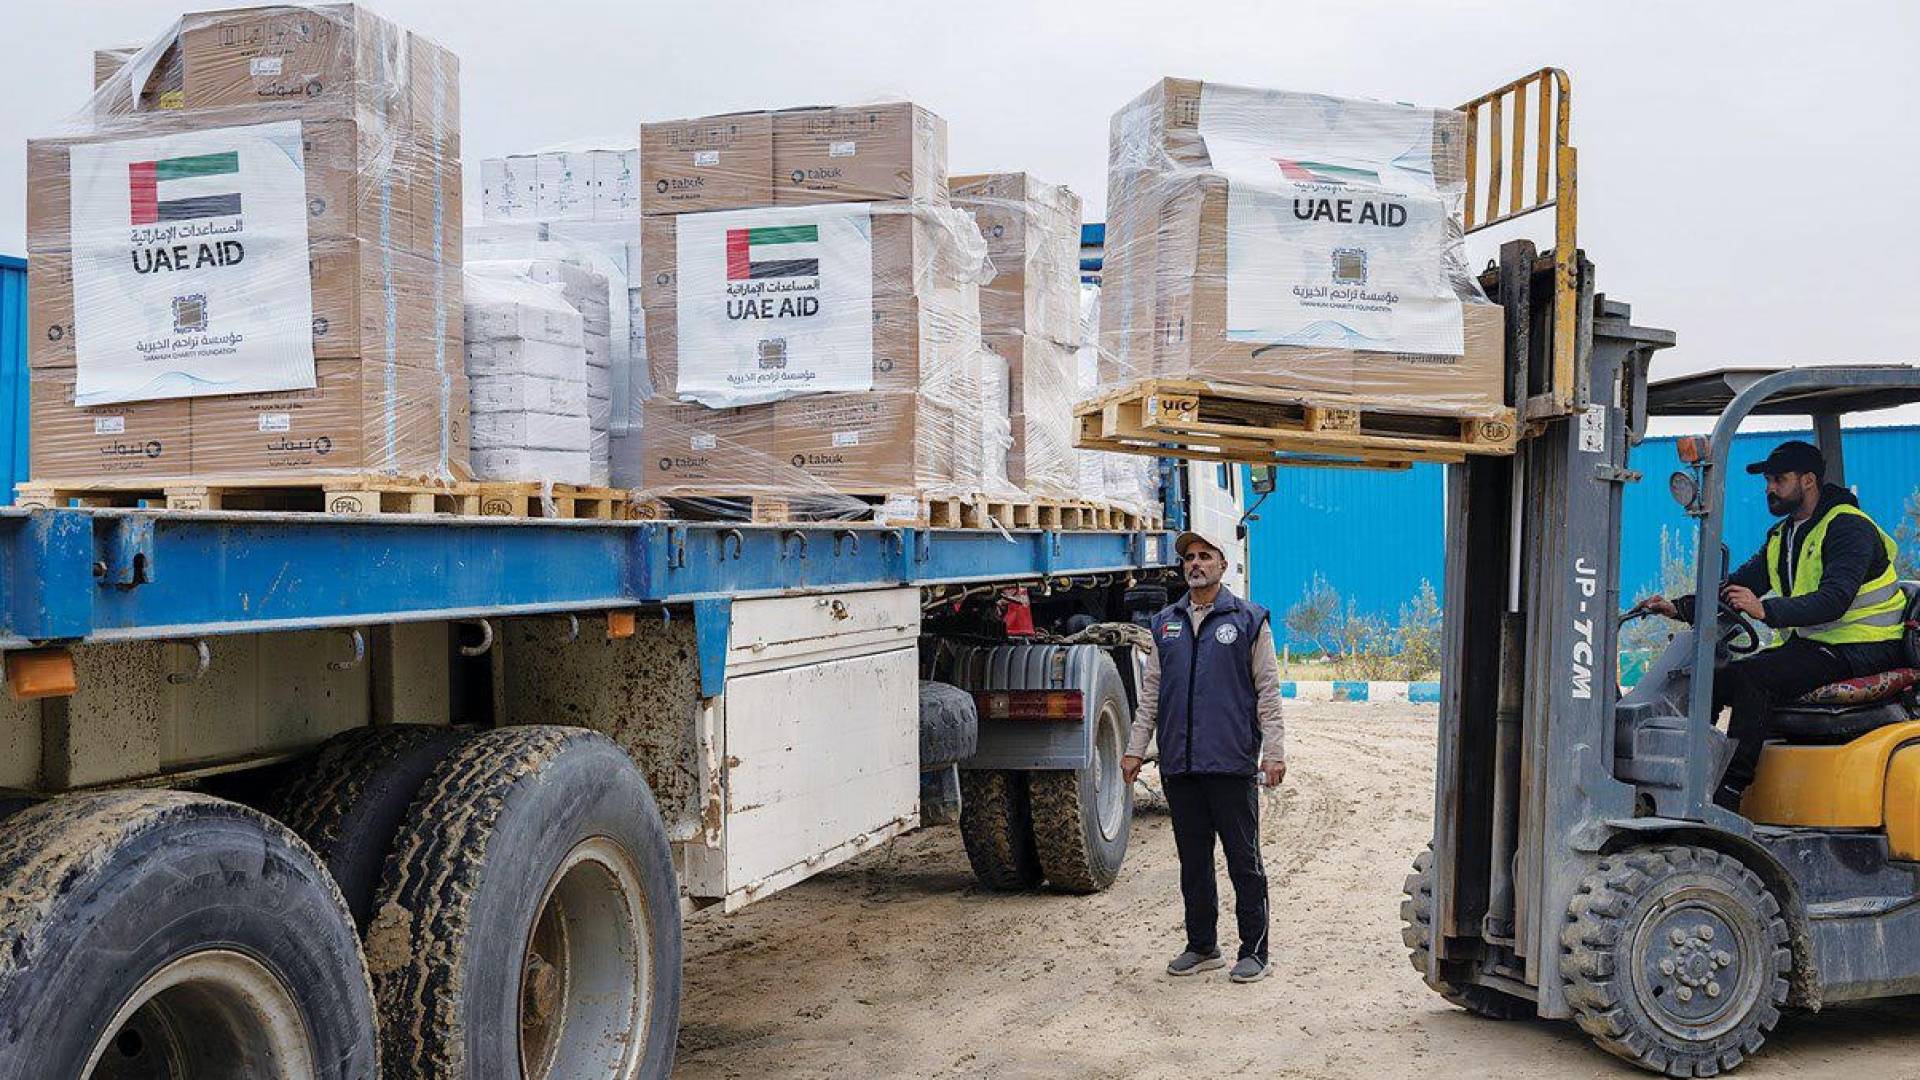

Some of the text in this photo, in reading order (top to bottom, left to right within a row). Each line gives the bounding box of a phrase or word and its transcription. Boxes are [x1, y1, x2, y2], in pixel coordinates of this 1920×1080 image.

[808, 167, 842, 179] tabuk
[1294, 199, 1408, 227] UAE AID
[179, 219, 243, 238] المساعدات
[131, 240, 245, 274] UAE AID
[1293, 285, 1399, 305] مؤسسة تراحم الخيرية
[727, 296, 819, 320] UAE AID
[200, 332, 243, 346] مؤسسة
[809, 453, 843, 465] tabuk
[336, 500, 358, 512] EPAL
